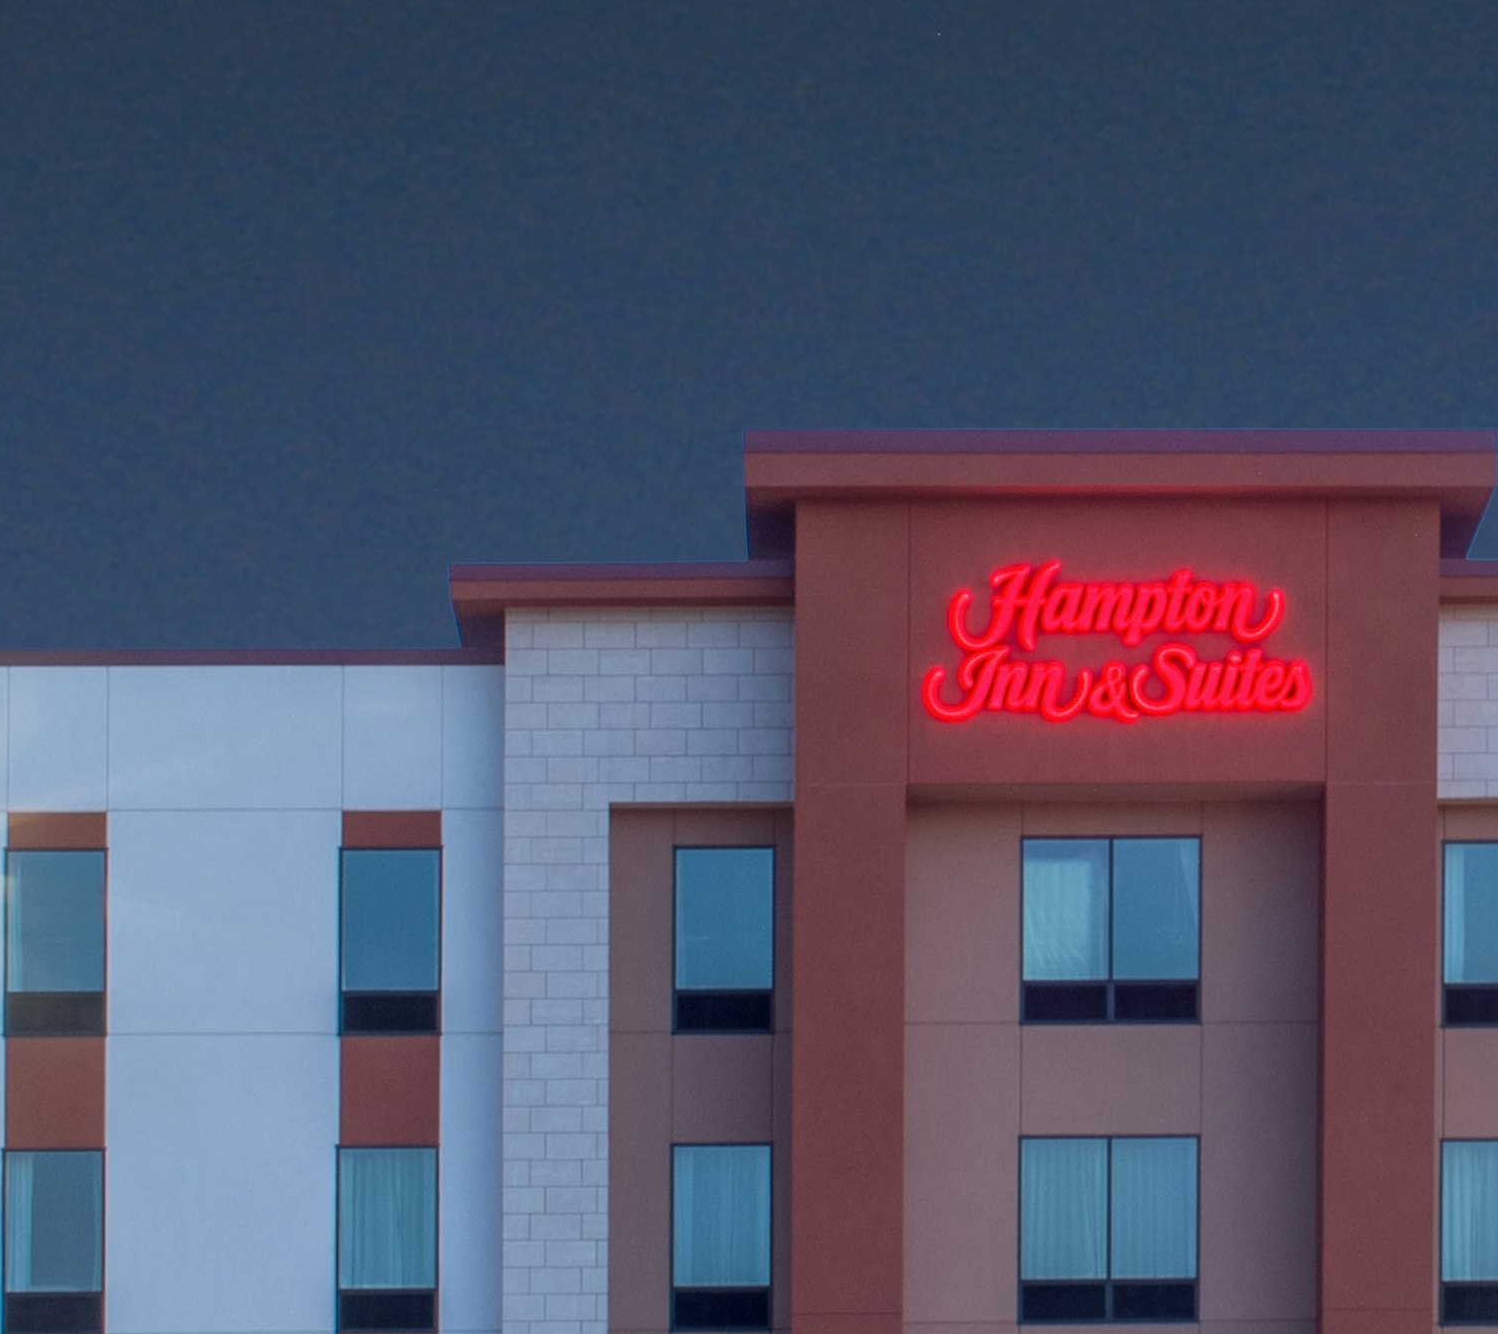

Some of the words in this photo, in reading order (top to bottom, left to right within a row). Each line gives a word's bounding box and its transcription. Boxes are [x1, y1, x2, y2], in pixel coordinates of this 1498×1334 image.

[949, 560, 1285, 651] Hampton
[922, 645, 1092, 723] Inn
[1087, 660, 1141, 723] &
[1130, 643, 1312, 715] Suites
